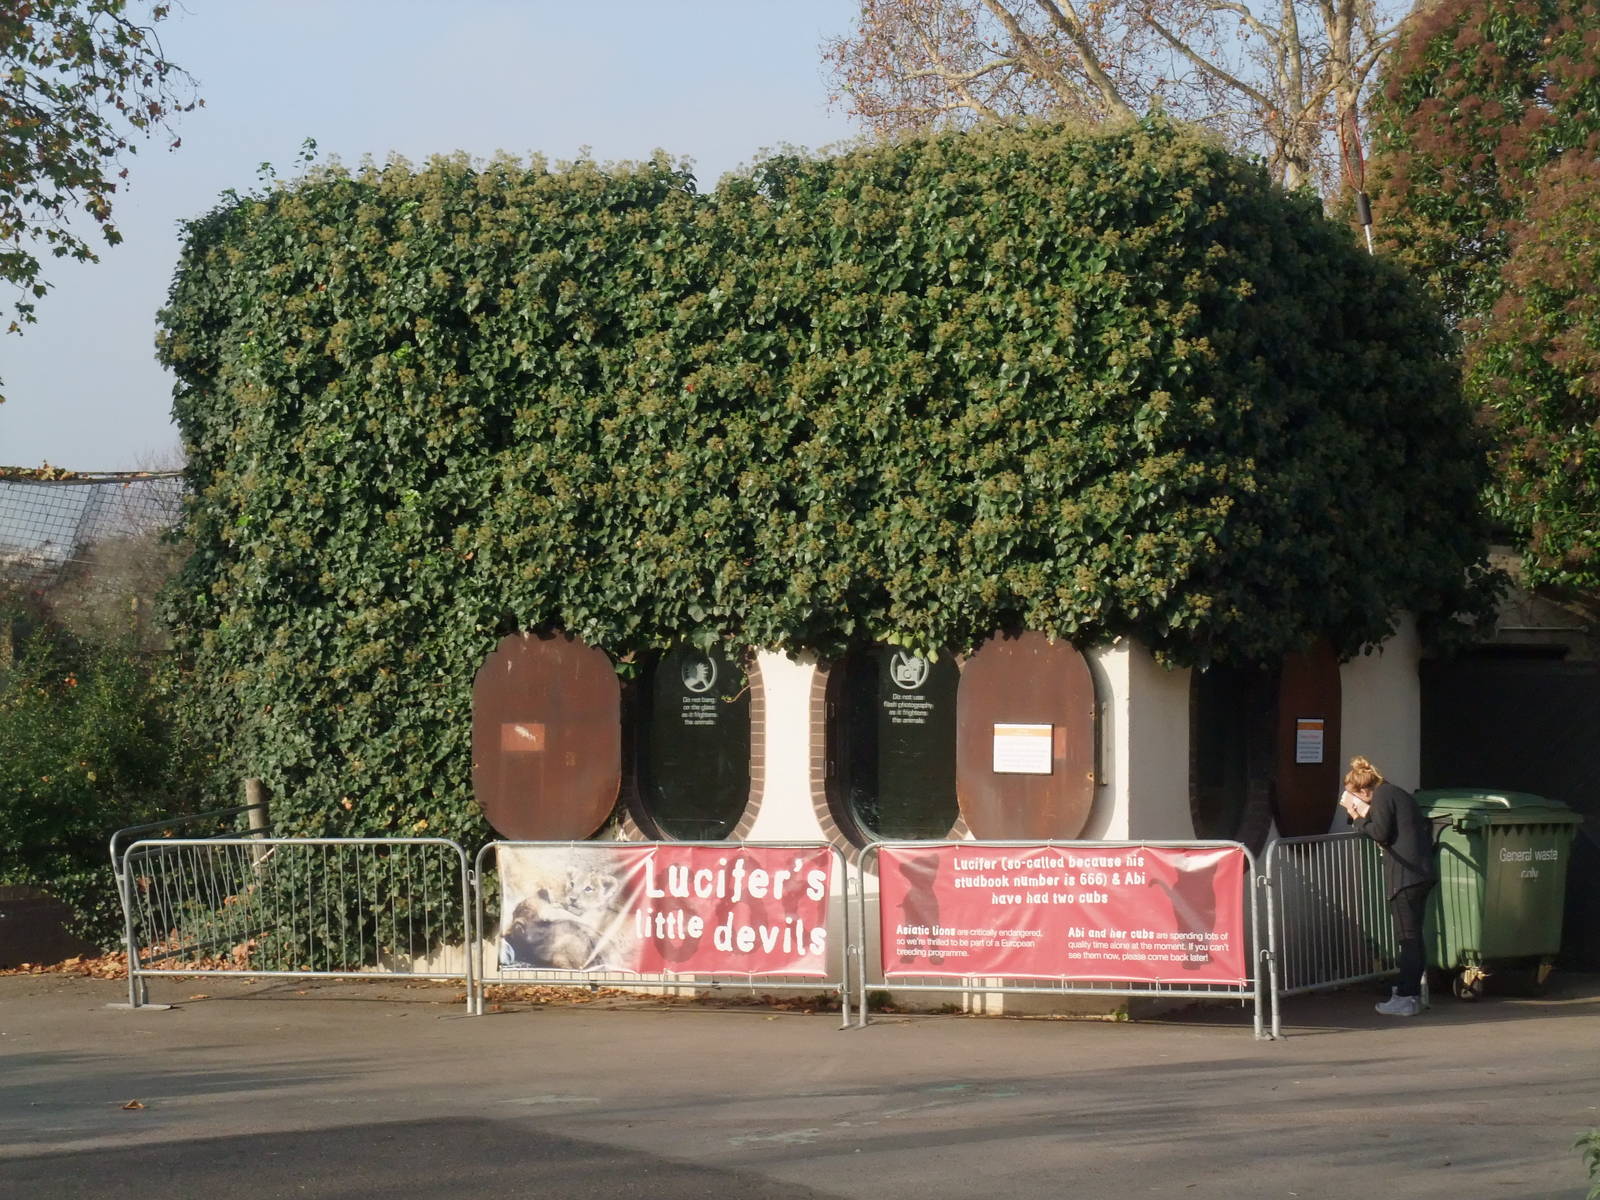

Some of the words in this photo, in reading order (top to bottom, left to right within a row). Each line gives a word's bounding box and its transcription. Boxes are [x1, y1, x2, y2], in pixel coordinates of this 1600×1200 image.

[1500, 847, 1533, 862] General
[1534, 849, 1558, 861] waste
[954, 857, 998, 871] Lucifer
[1001, 855, 1065, 871] (so-called
[1069, 855, 1122, 868] because
[1126, 854, 1145, 867] his
[645, 856, 827, 902] Lucifer's
[954, 874, 1010, 888] studbook
[1014, 874, 1060, 887] number
[1064, 873, 1076, 886] is
[1079, 872, 1108, 887] 666)
[1112, 873, 1121, 886] &
[1125, 872, 1146, 885] Abi
[992, 893, 1022, 905] have
[1026, 892, 1049, 904] had
[1053, 892, 1075, 904] two
[1078, 891, 1109, 904] cubs
[635, 907, 704, 940] little
[713, 911, 828, 956] devils
[896, 925, 930, 936] Asiatic
[932, 925, 956, 936] lions
[970, 928, 998, 938] critically
[1067, 927, 1086, 938] Abi
[1088, 928, 1107, 938] and
[1110, 928, 1127, 939] her
[1130, 928, 1155, 939] cubs
[1170, 932, 1204, 942] spending
[1205, 932, 1219, 940] lots
[1220, 932, 1229, 940] of
[907, 938, 924, 946] we're
[927, 938, 949, 946] thrilled
[950, 938, 959, 946] to
[959, 938, 970, 946] be
[970, 938, 985, 948] part
[986, 939, 994, 947] of
[1001, 939, 1036, 949] European
[1068, 941, 1092, 950] quality
[1092, 940, 1109, 949] time
[1110, 941, 1131, 949] alone
[1131, 942, 1140, 950] at
[1140, 941, 1153, 950] the
[1154, 942, 1187, 951] moment.
[1188, 942, 1195, 951] If
[1195, 943, 1208, 952] you
[1210, 943, 1230, 952] can't
[896, 948, 927, 958] breeding
[1083, 951, 1102, 959] them
[1122, 953, 1147, 962] please
[1170, 953, 1189, 962] back
[1190, 953, 1209, 962] later!
